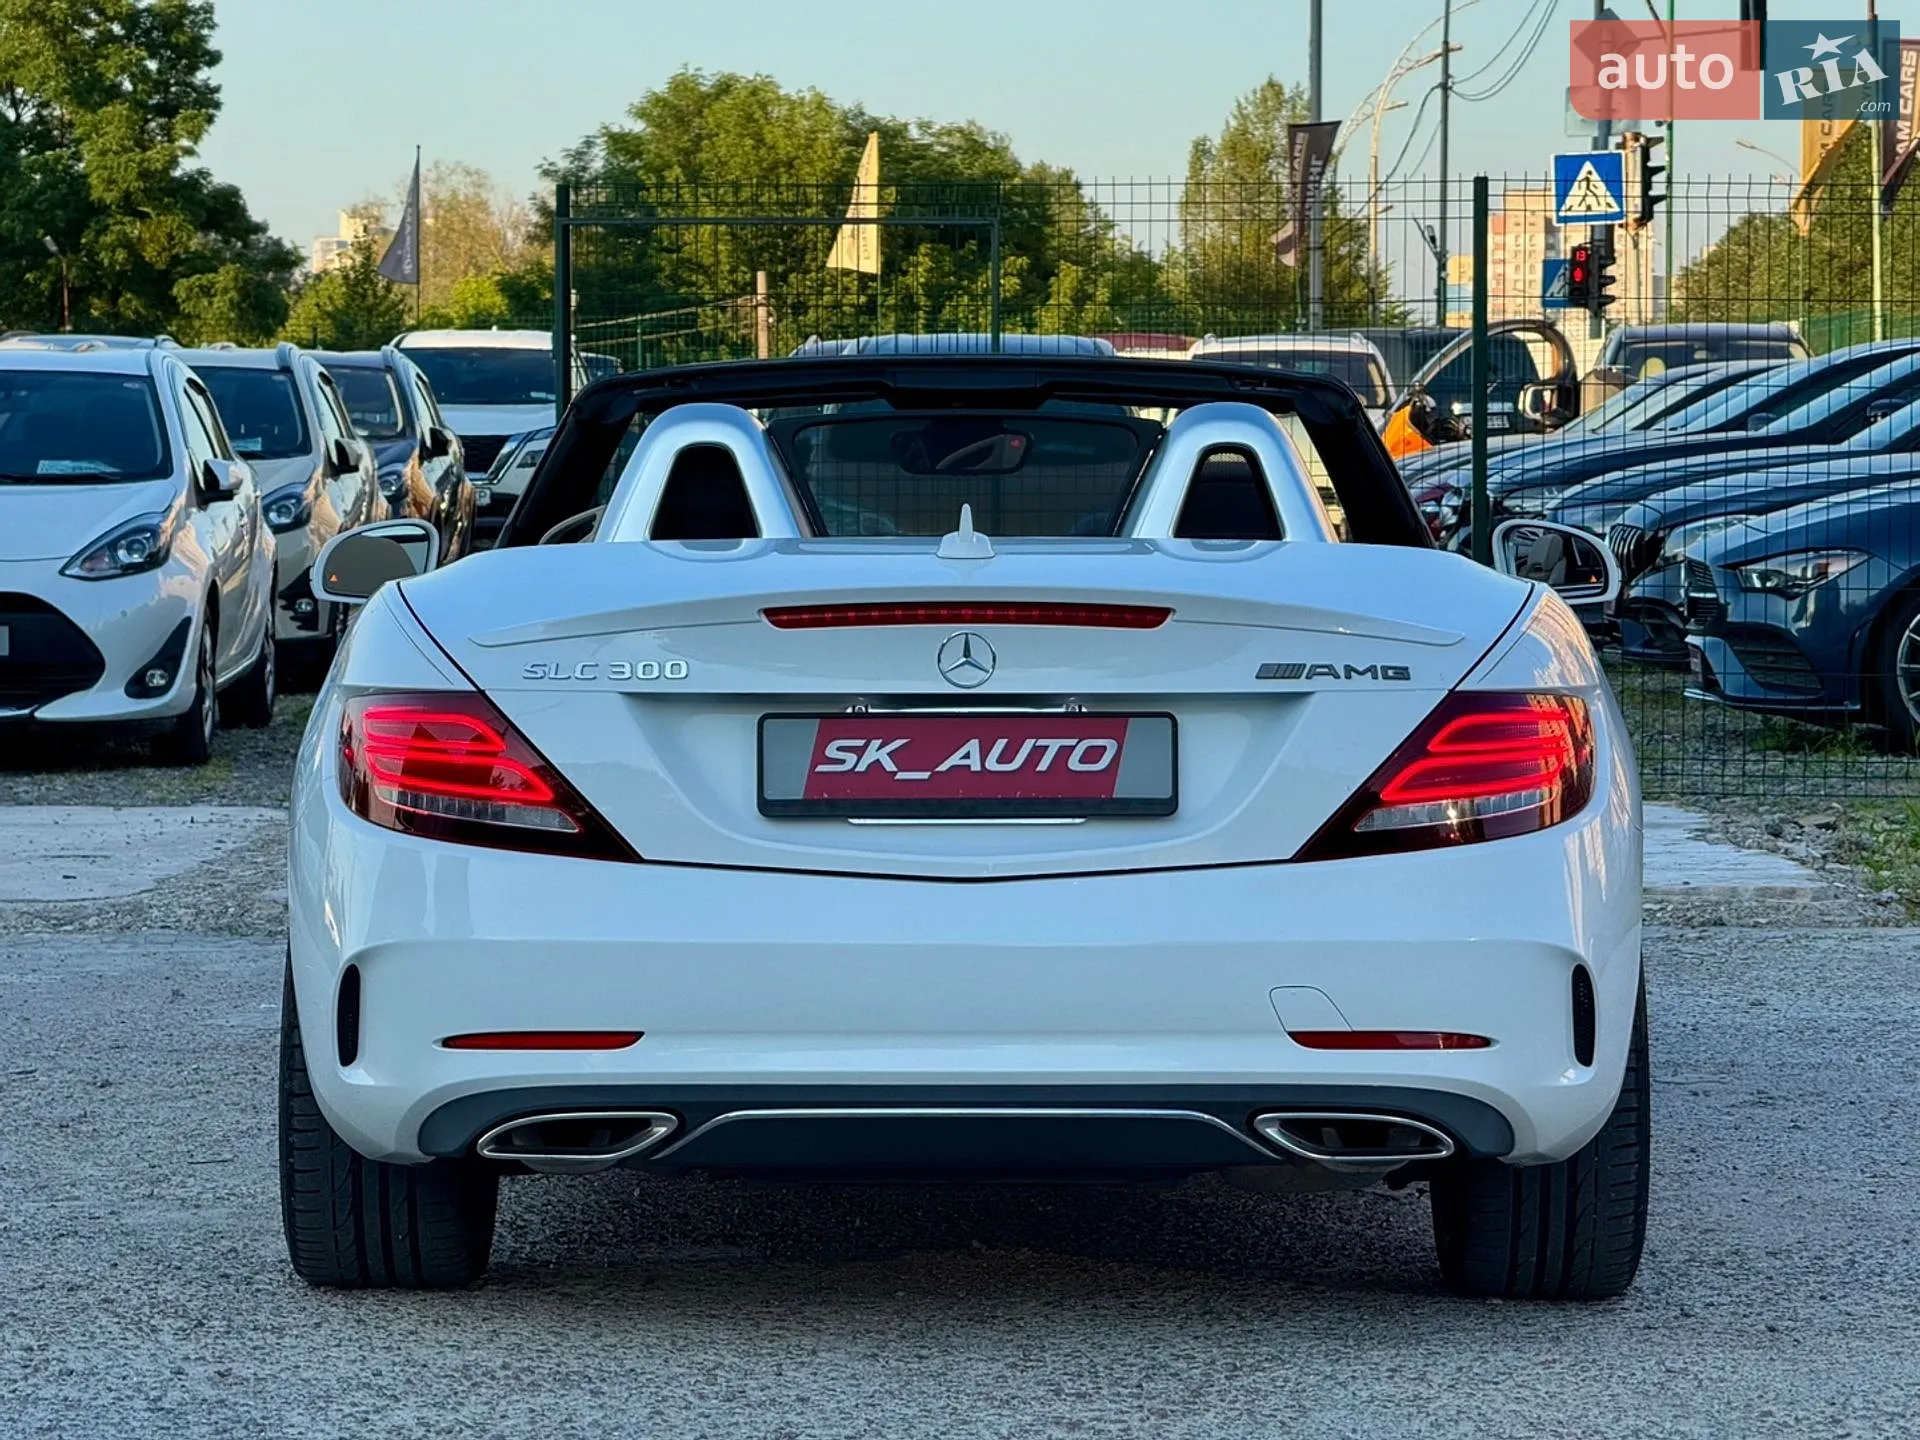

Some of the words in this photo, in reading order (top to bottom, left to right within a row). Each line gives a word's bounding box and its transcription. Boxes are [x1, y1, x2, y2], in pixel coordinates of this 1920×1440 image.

[1900, 49, 1917, 115] CARS
[522, 661, 599, 681] SLC
[607, 659, 689, 681] 300
[1305, 663, 1411, 681] AMG
[814, 738, 1119, 780] SK_AUTO
